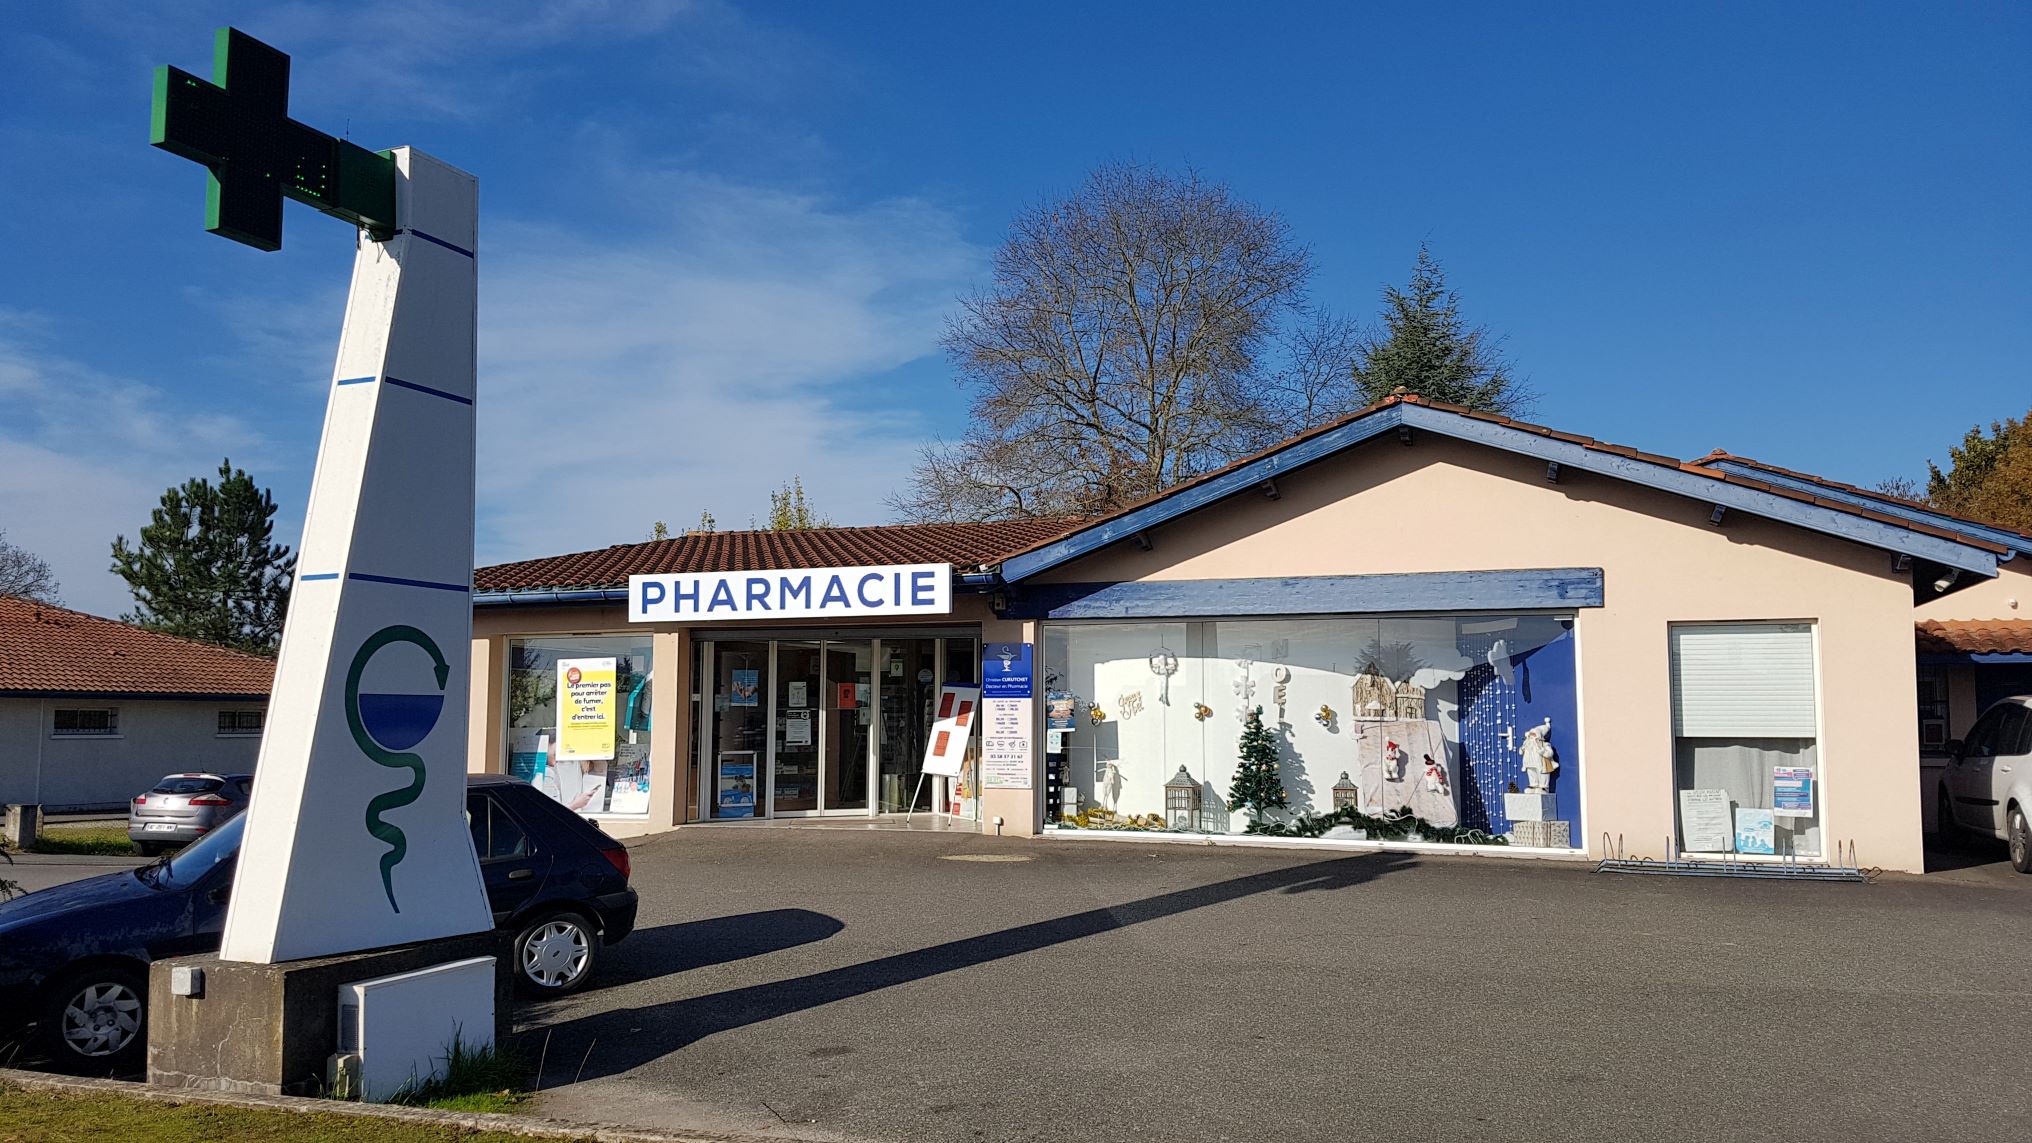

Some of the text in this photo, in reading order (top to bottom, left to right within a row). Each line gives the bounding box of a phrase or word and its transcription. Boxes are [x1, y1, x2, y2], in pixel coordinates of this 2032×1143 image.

[641, 571, 935, 614] PHARMACIE
[575, 682, 599, 690] premier
[599, 682, 611, 690] pas
